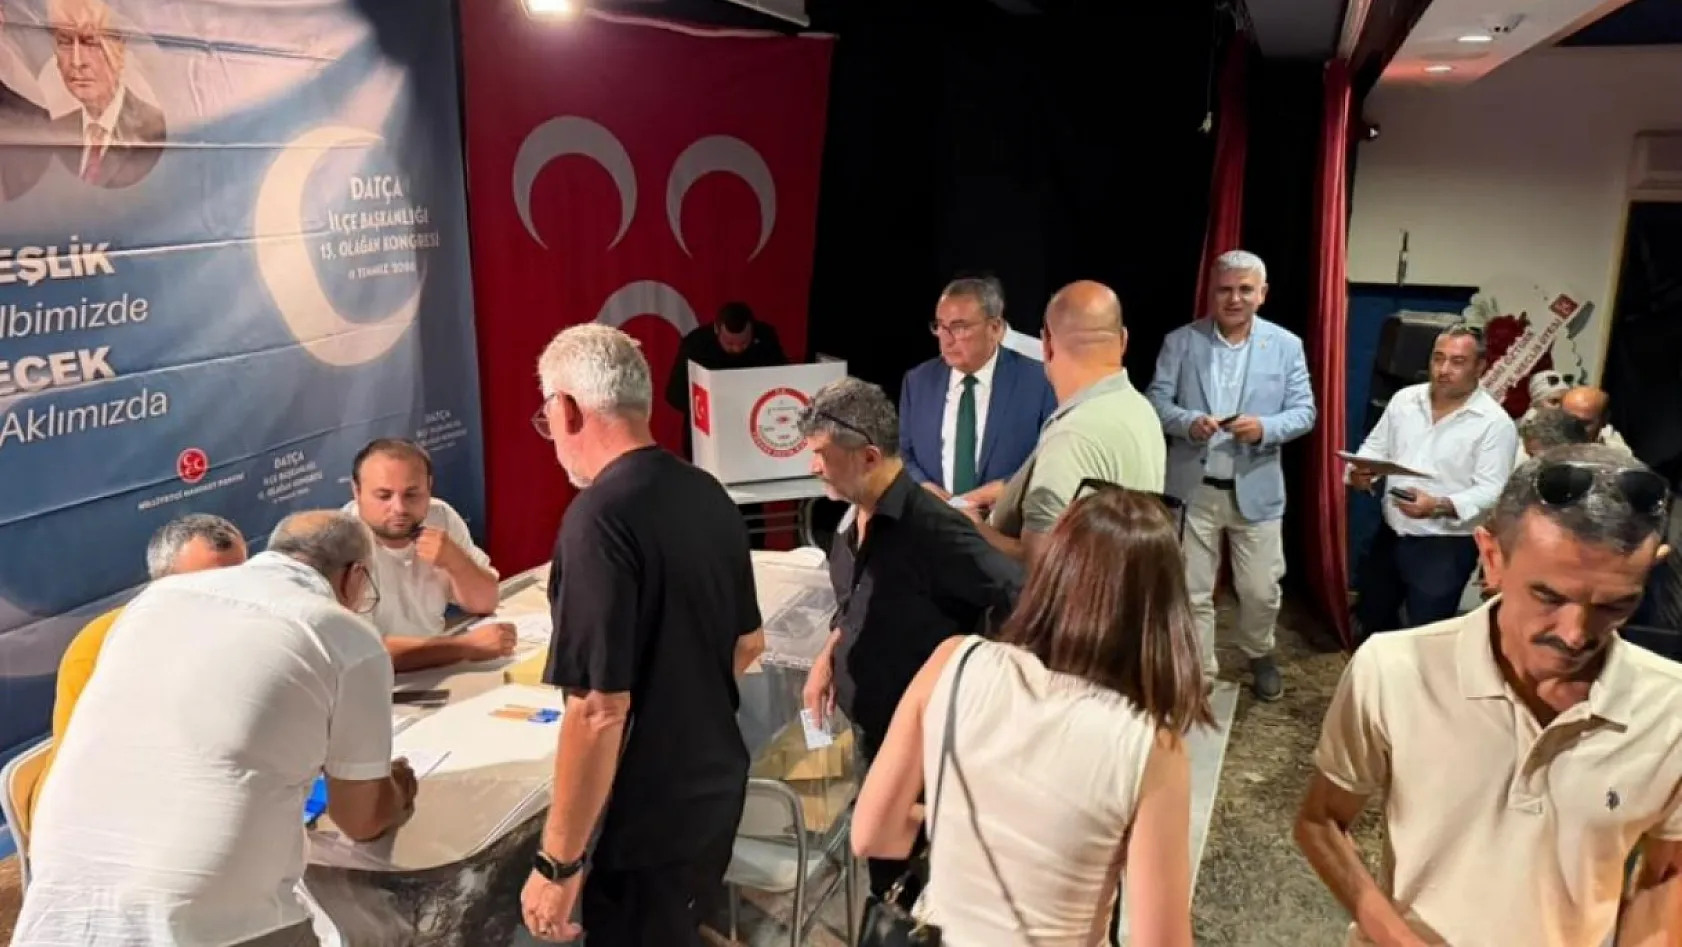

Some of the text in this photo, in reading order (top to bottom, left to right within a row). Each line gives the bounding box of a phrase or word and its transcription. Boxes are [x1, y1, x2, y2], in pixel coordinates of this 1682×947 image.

[351, 175, 404, 204] DATÇA
[328, 209, 358, 234] İLÇE
[0, 292, 149, 340] lbimizde
[0, 387, 168, 447] Aklımızda
